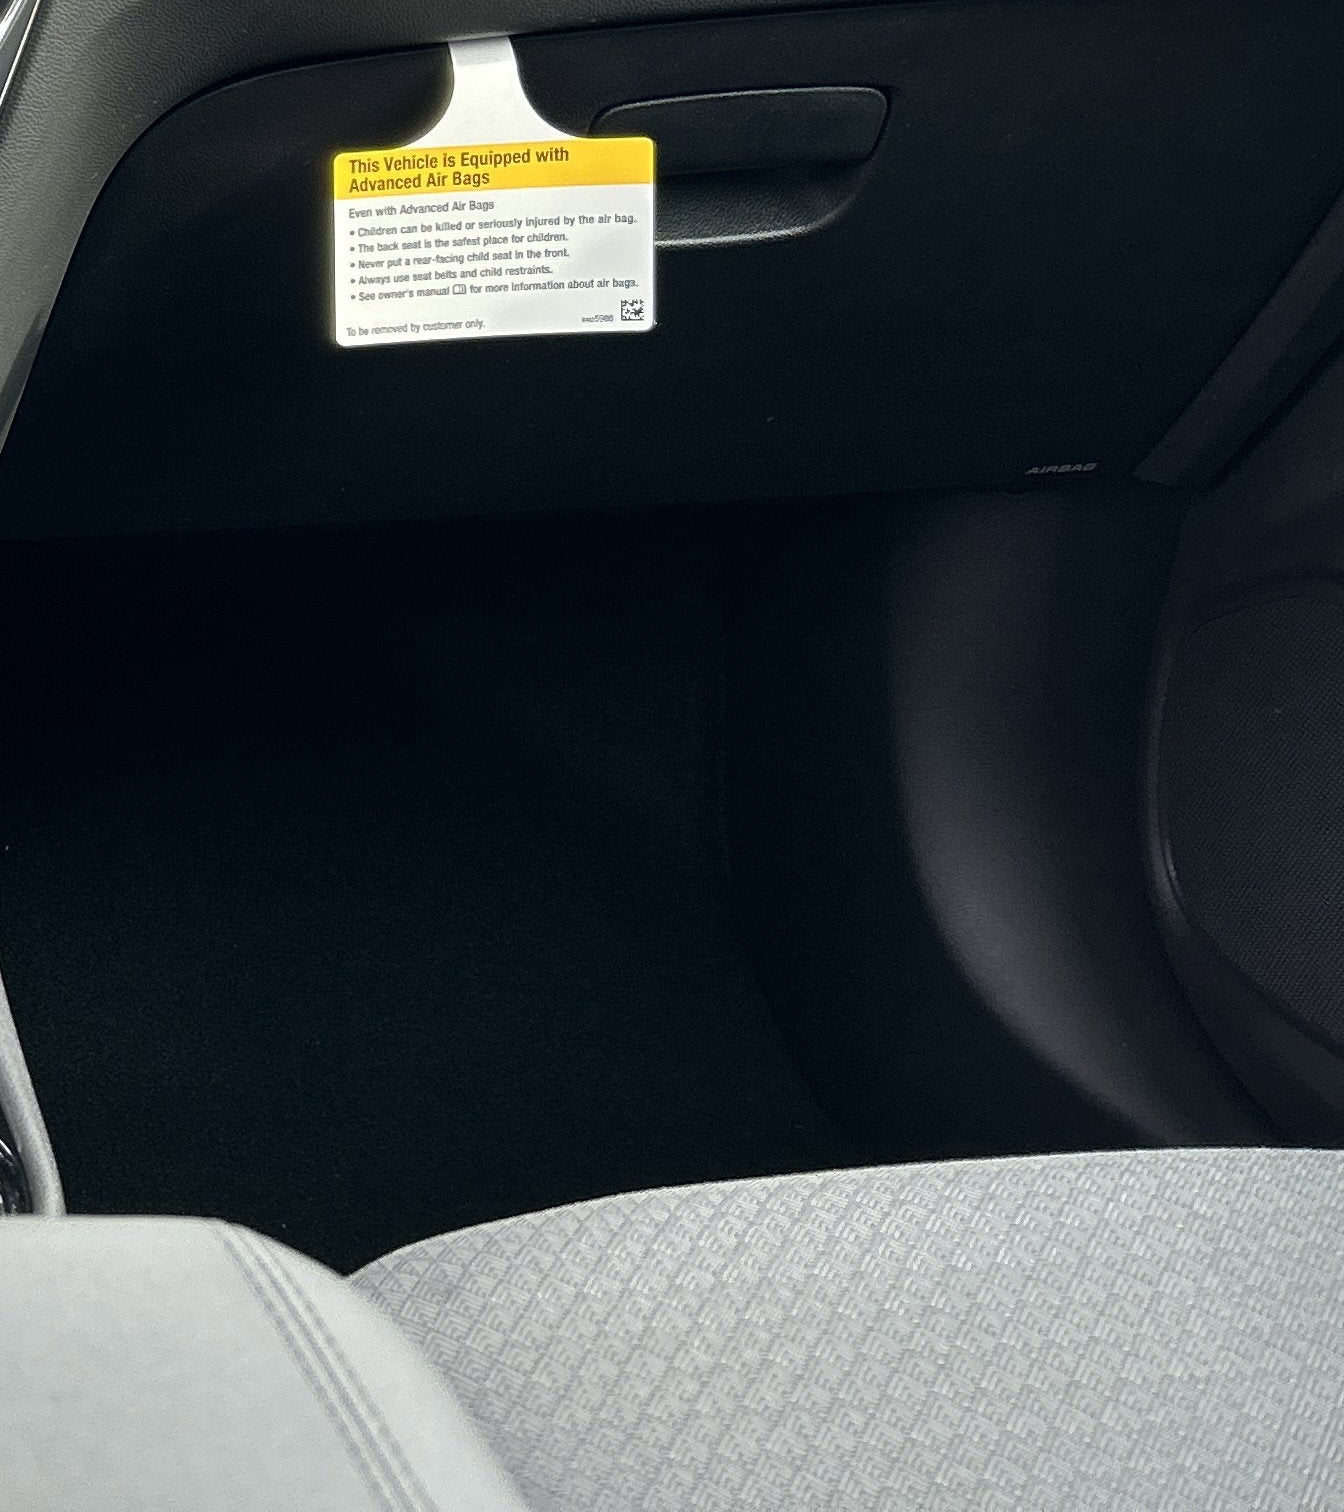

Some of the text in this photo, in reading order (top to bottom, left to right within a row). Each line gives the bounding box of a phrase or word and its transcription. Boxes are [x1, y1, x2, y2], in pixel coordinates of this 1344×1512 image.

[349, 147, 569, 174] This Vehicle is Equipped with
[349, 170, 490, 193] Advanced Air Bags
[349, 200, 494, 218] Even with Advanced Air Bags
[358, 213, 637, 237] Children can be killed or seriously injured by the air bag.
[358, 232, 569, 253] The back seat is the safest place for children.
[359, 248, 570, 269] Never put a rear-facing child seat in the front.
[359, 265, 553, 285] Always use seat belts and child restraints.
[359, 278, 639, 301] See owner's manual for more information about air bags.
[347, 319, 485, 337] To be removed by customer only.
[1024, 462, 1099, 475] AIRBAG
